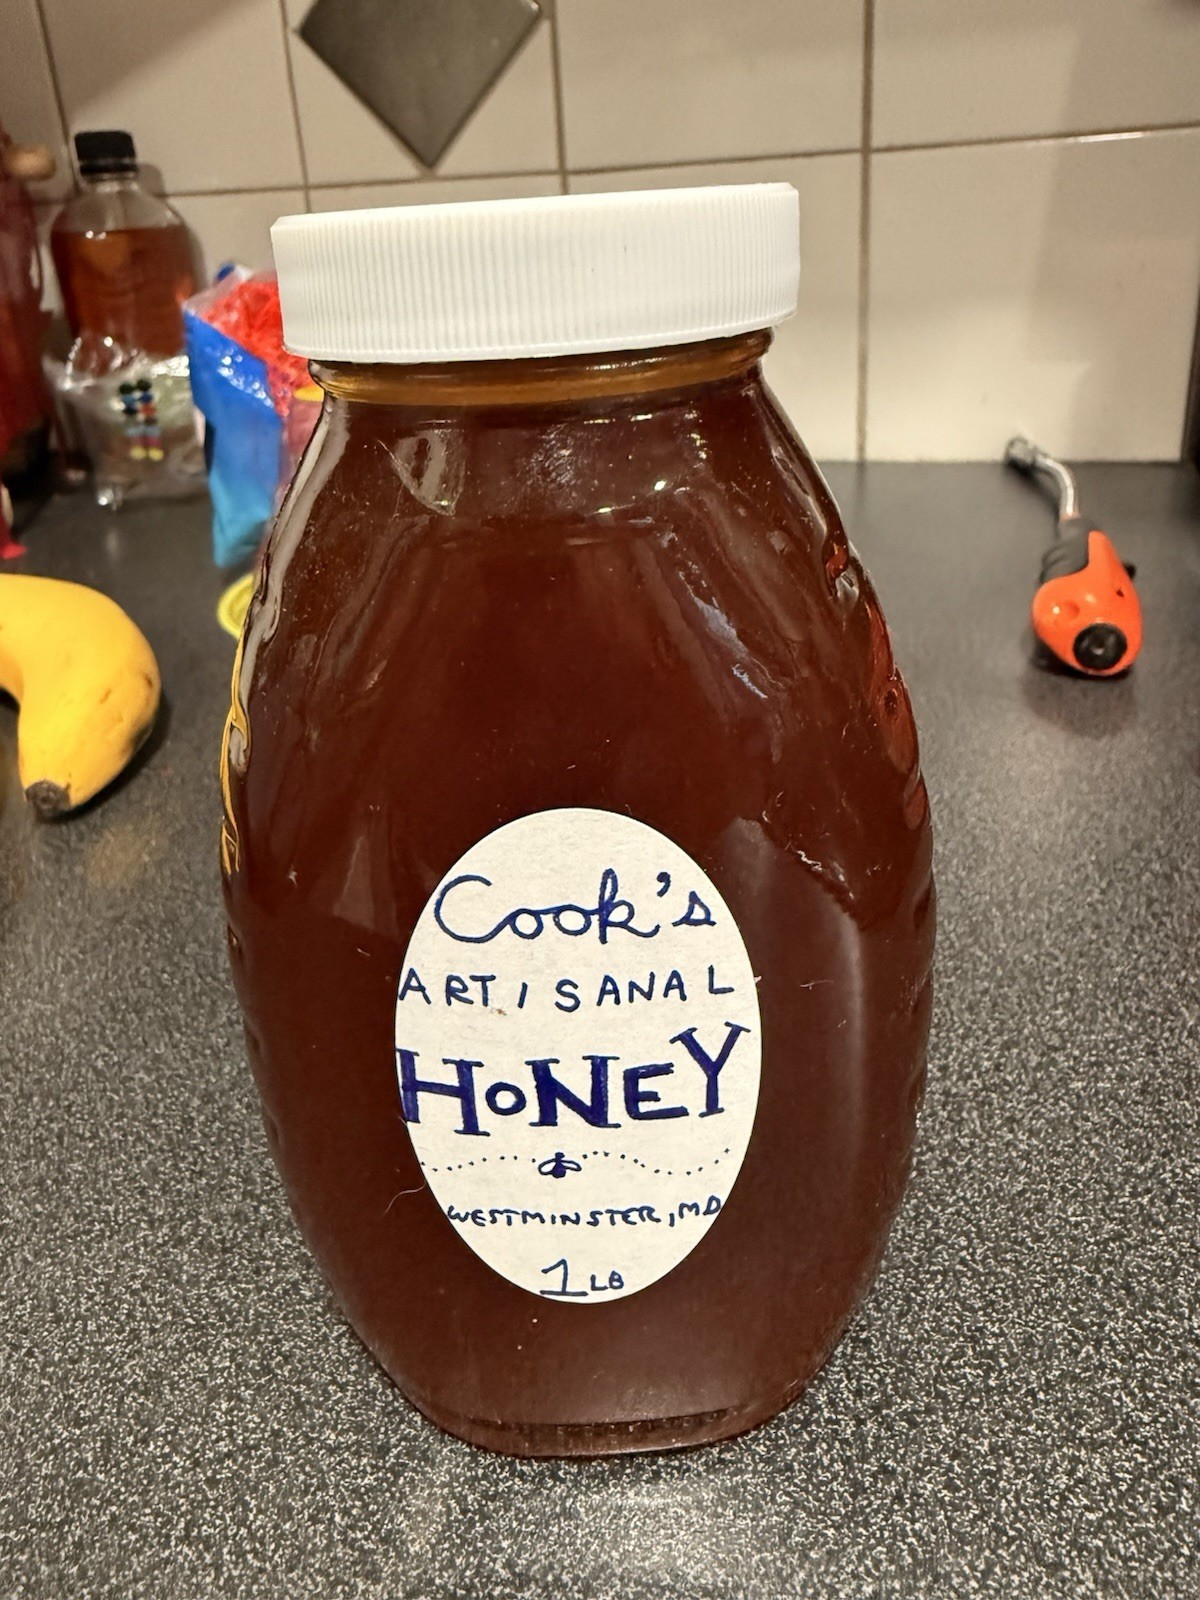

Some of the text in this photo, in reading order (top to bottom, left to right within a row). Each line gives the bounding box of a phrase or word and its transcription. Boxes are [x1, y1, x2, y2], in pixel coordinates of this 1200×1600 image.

[434, 867, 716, 944] Cook's
[398, 964, 736, 1013] ARTISANAL
[539, 1258, 625, 1297] 1 LB
